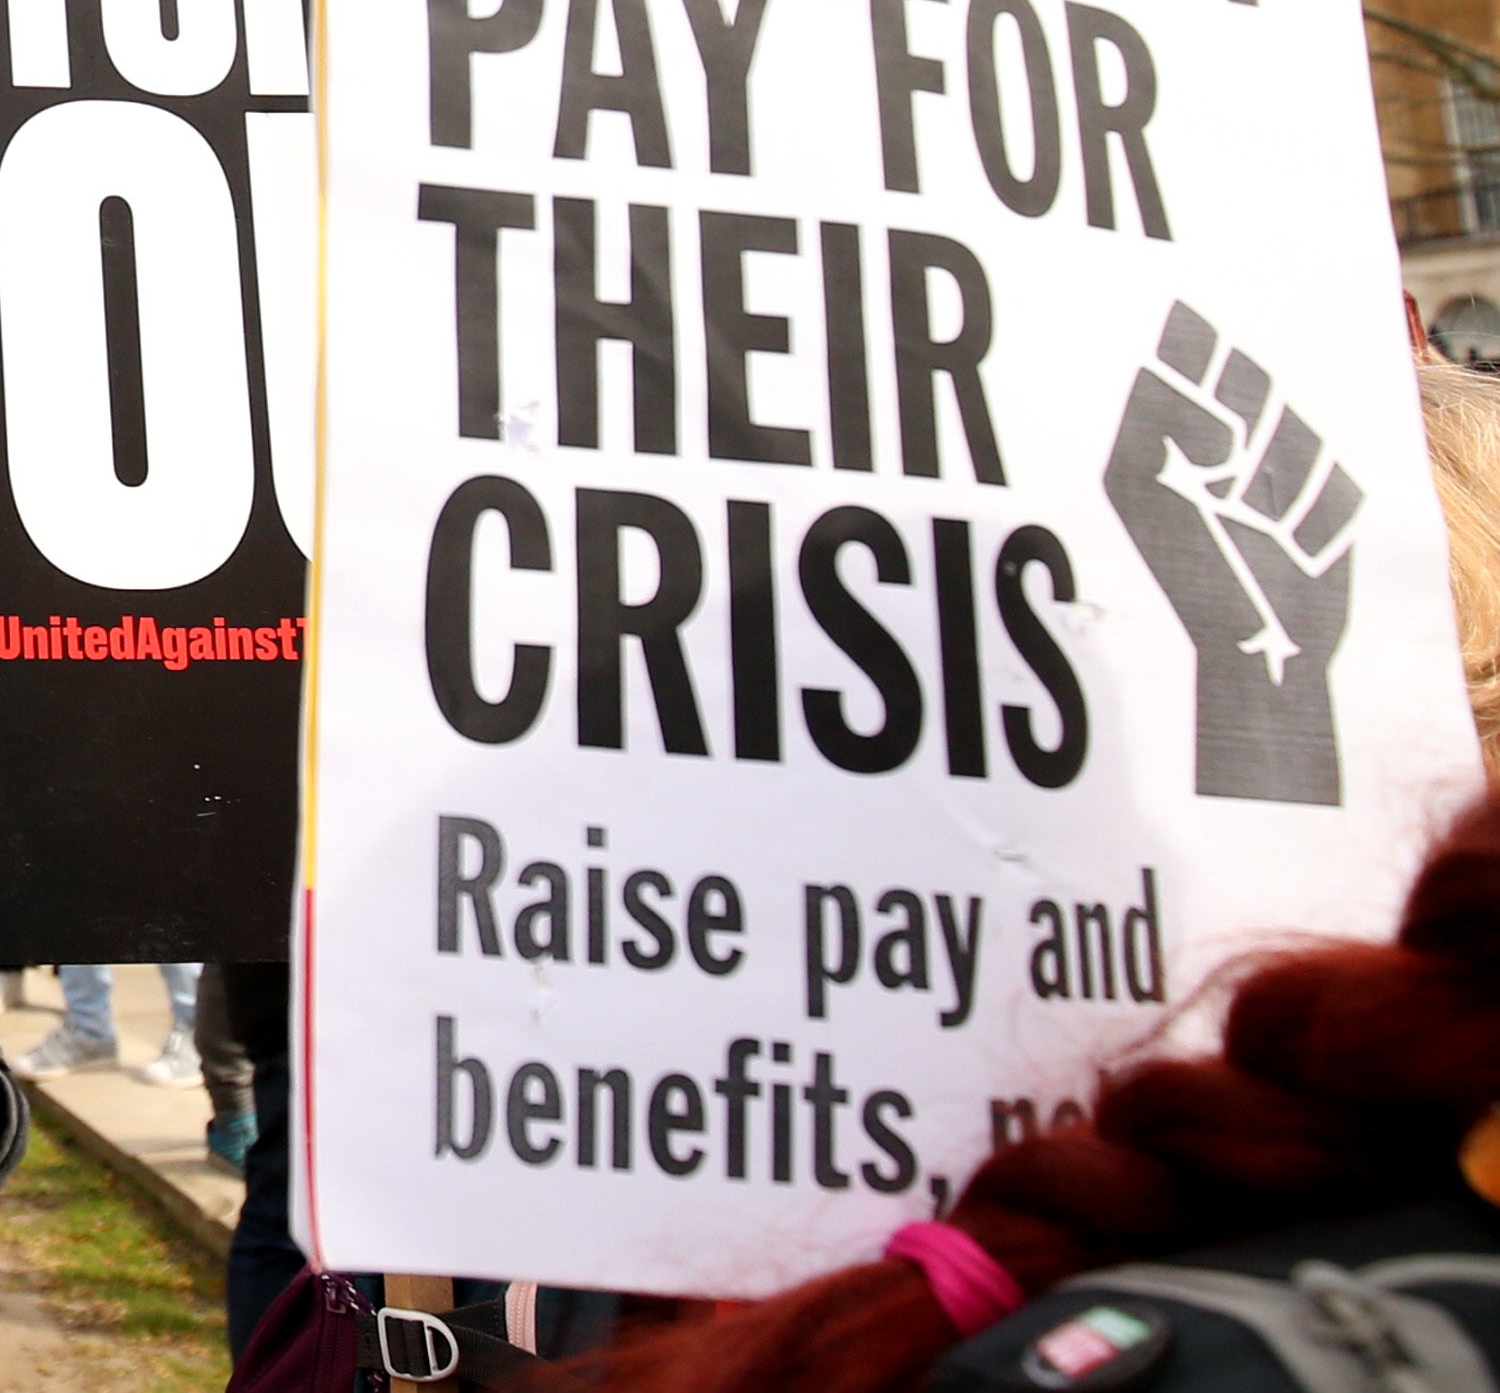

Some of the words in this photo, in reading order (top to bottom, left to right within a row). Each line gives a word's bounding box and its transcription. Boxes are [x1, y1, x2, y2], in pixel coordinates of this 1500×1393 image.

[418, 182, 1008, 487] THEIR
[425, 475, 1089, 789] CRISIS
[437, 814, 745, 974] Raise
[805, 882, 982, 1028] pay
[1029, 866, 1165, 1004] and
[434, 1016, 950, 1218] benefits,
